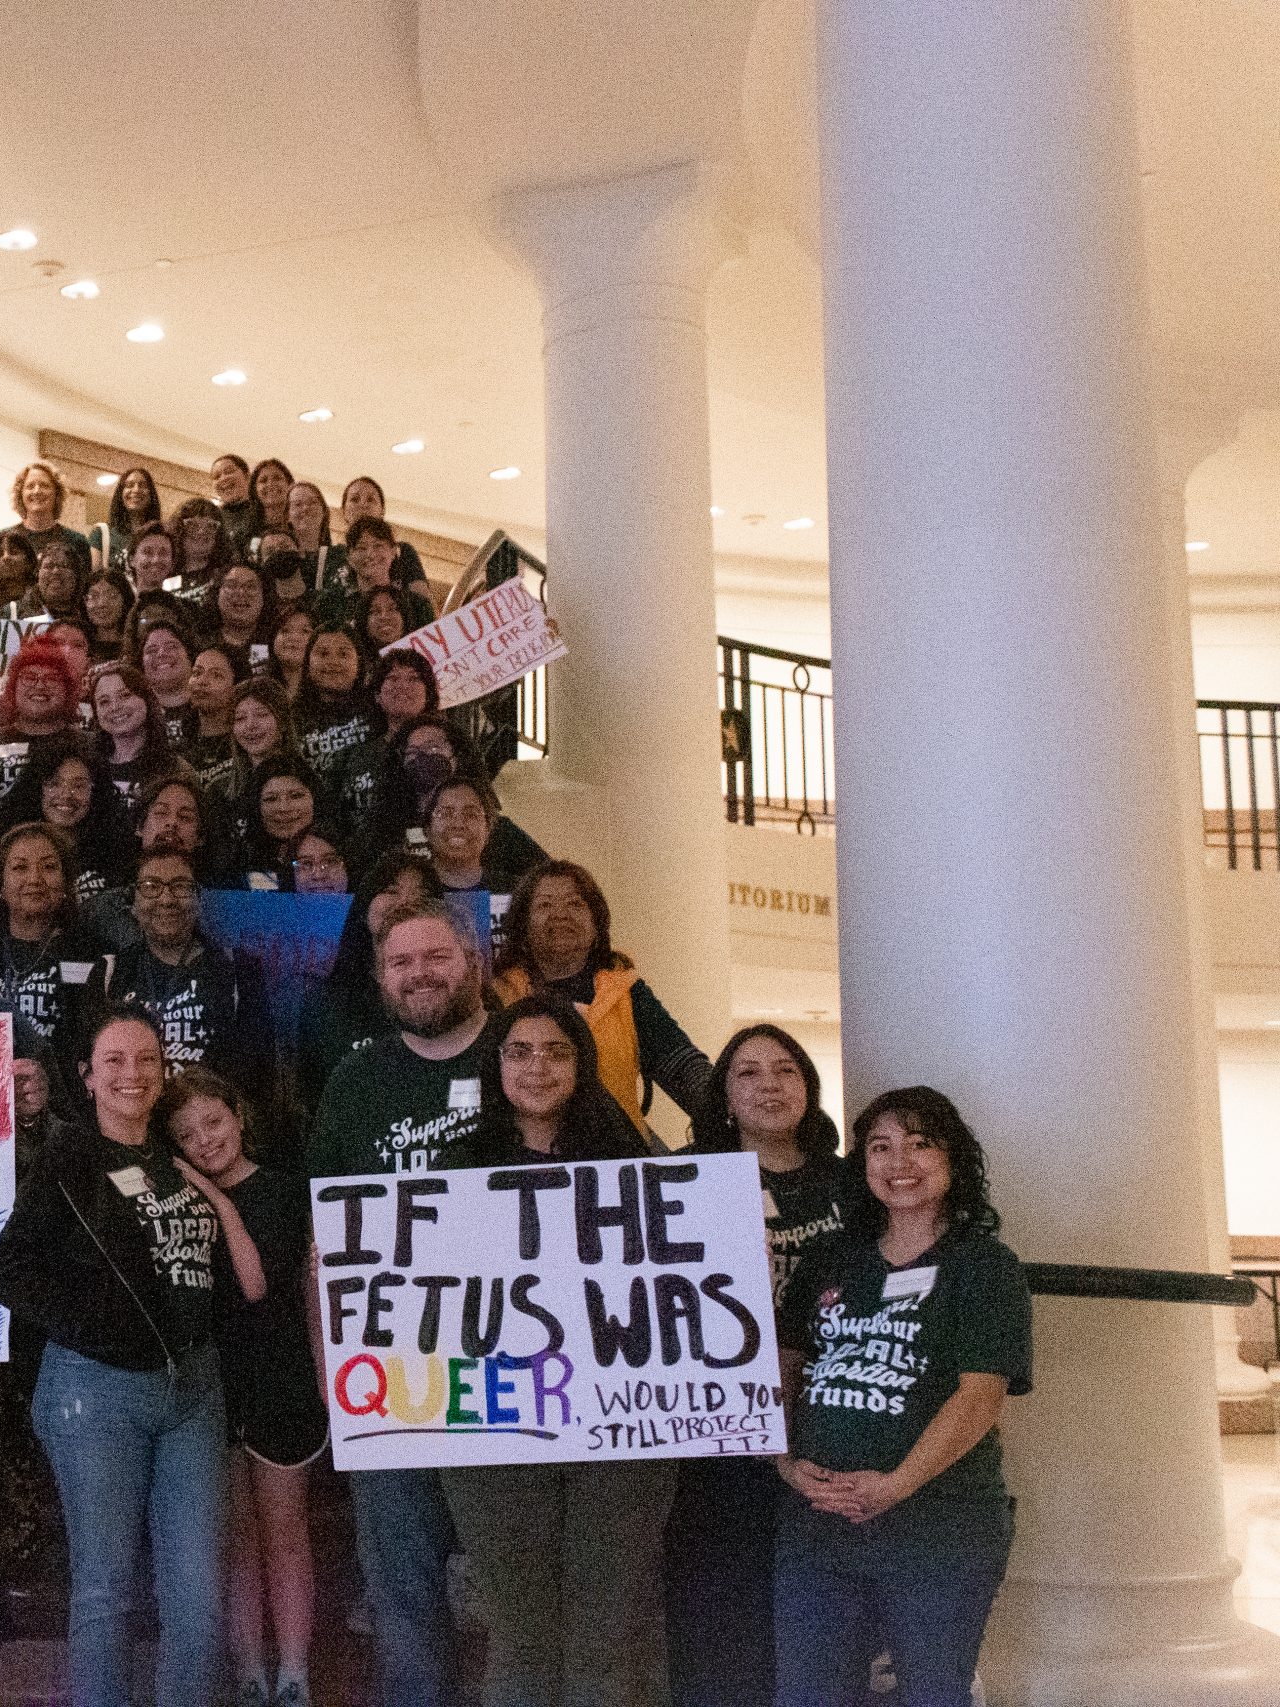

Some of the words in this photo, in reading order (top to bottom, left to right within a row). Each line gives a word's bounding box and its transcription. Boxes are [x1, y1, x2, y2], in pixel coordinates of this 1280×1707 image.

[486, 613, 538, 658] CARE
[726, 881, 832, 916] ITORIUM
[316, 1178, 449, 1268] IF
[487, 1161, 705, 1266] THE
[326, 1272, 564, 1368] FETUS
[583, 1272, 761, 1369] WAS
[595, 1380, 727, 1417] WOULD
[809, 1379, 906, 1416] funds
[587, 1418, 668, 1451] STILL
[664, 1412, 773, 1444] PROTECT
[711, 1433, 772, 1454] IT?
